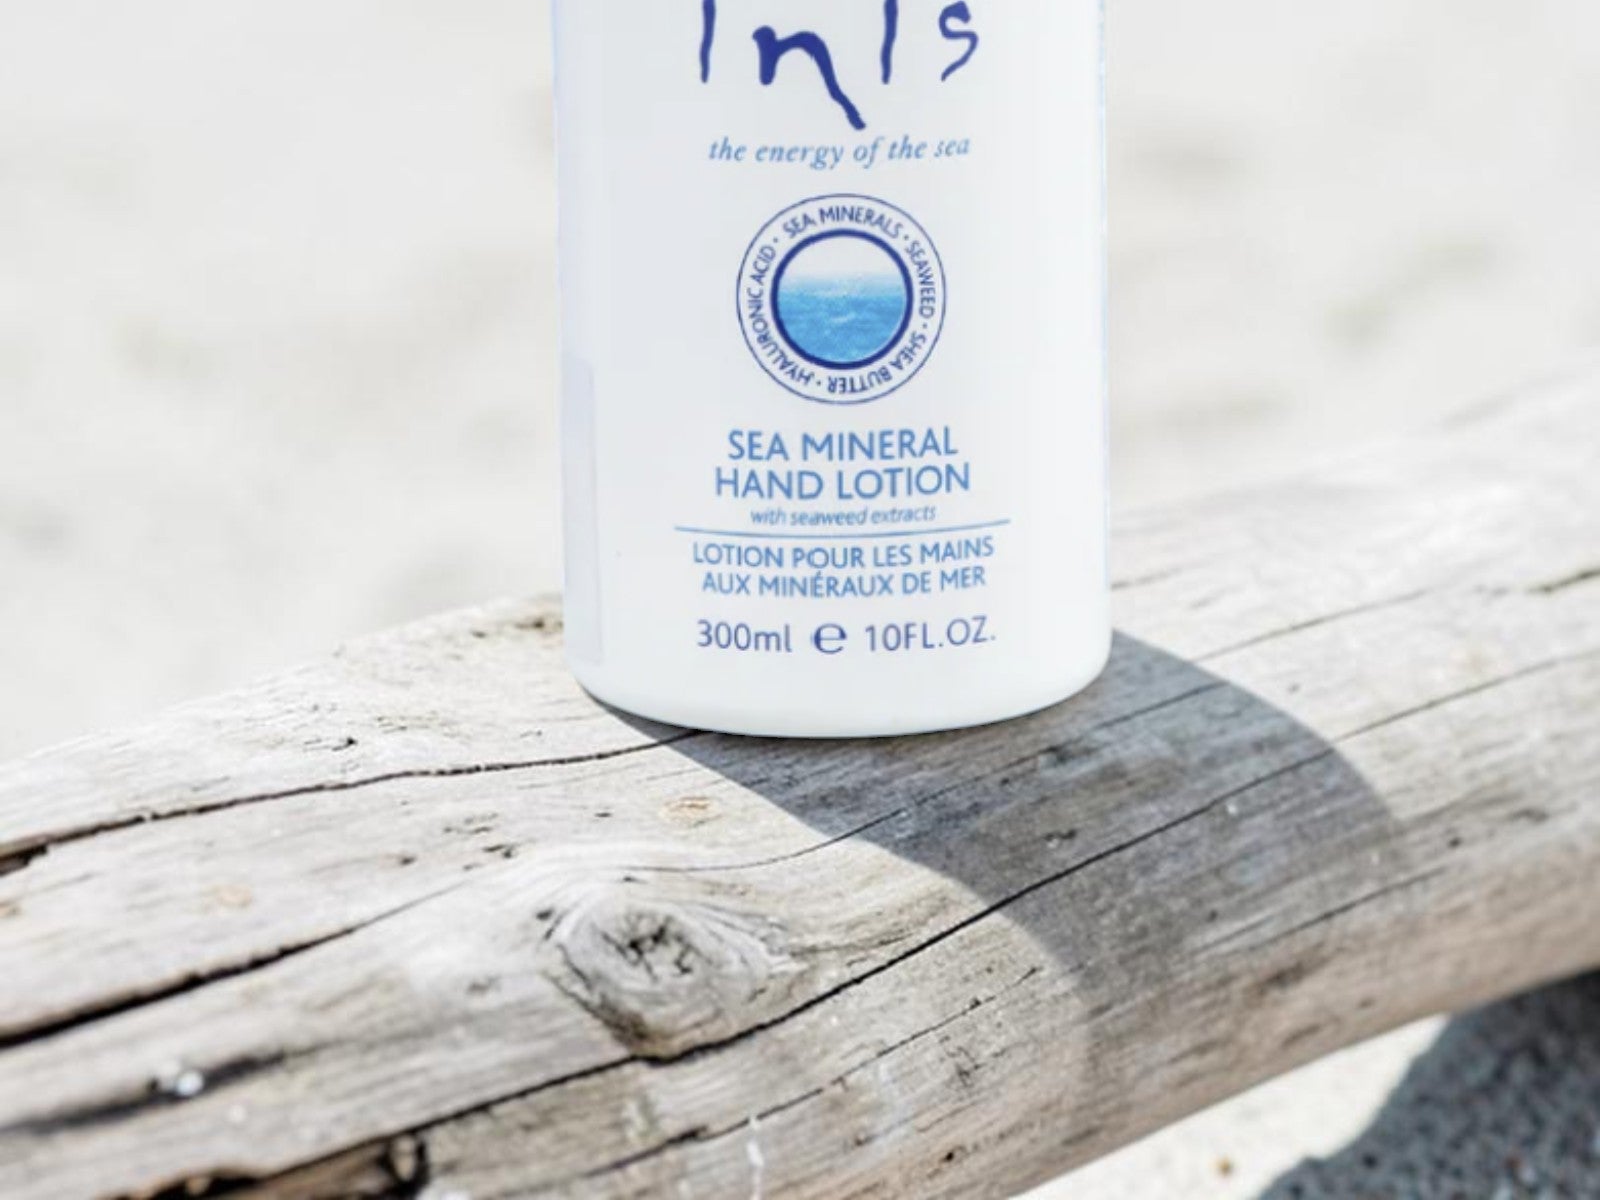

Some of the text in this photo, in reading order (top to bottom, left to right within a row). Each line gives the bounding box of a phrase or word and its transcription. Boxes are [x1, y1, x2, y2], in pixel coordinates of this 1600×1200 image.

[708, 135, 970, 170] the energy of the sea
[782, 205, 904, 240] SEA MINERALS
[904, 239, 936, 319] SEAWEED
[747, 244, 815, 386] HYALURONIC ACID
[827, 331, 927, 395] SHEA BUTTER
[728, 426, 959, 461] SEA MINERAL
[715, 462, 970, 500] HAND LOTION
[750, 504, 936, 526] with seaweed extracts
[692, 536, 994, 569] LOTION POUR LES MAINS
[702, 566, 986, 598] AUX MINÉRAUX DE MER
[697, 619, 793, 653] 300ml
